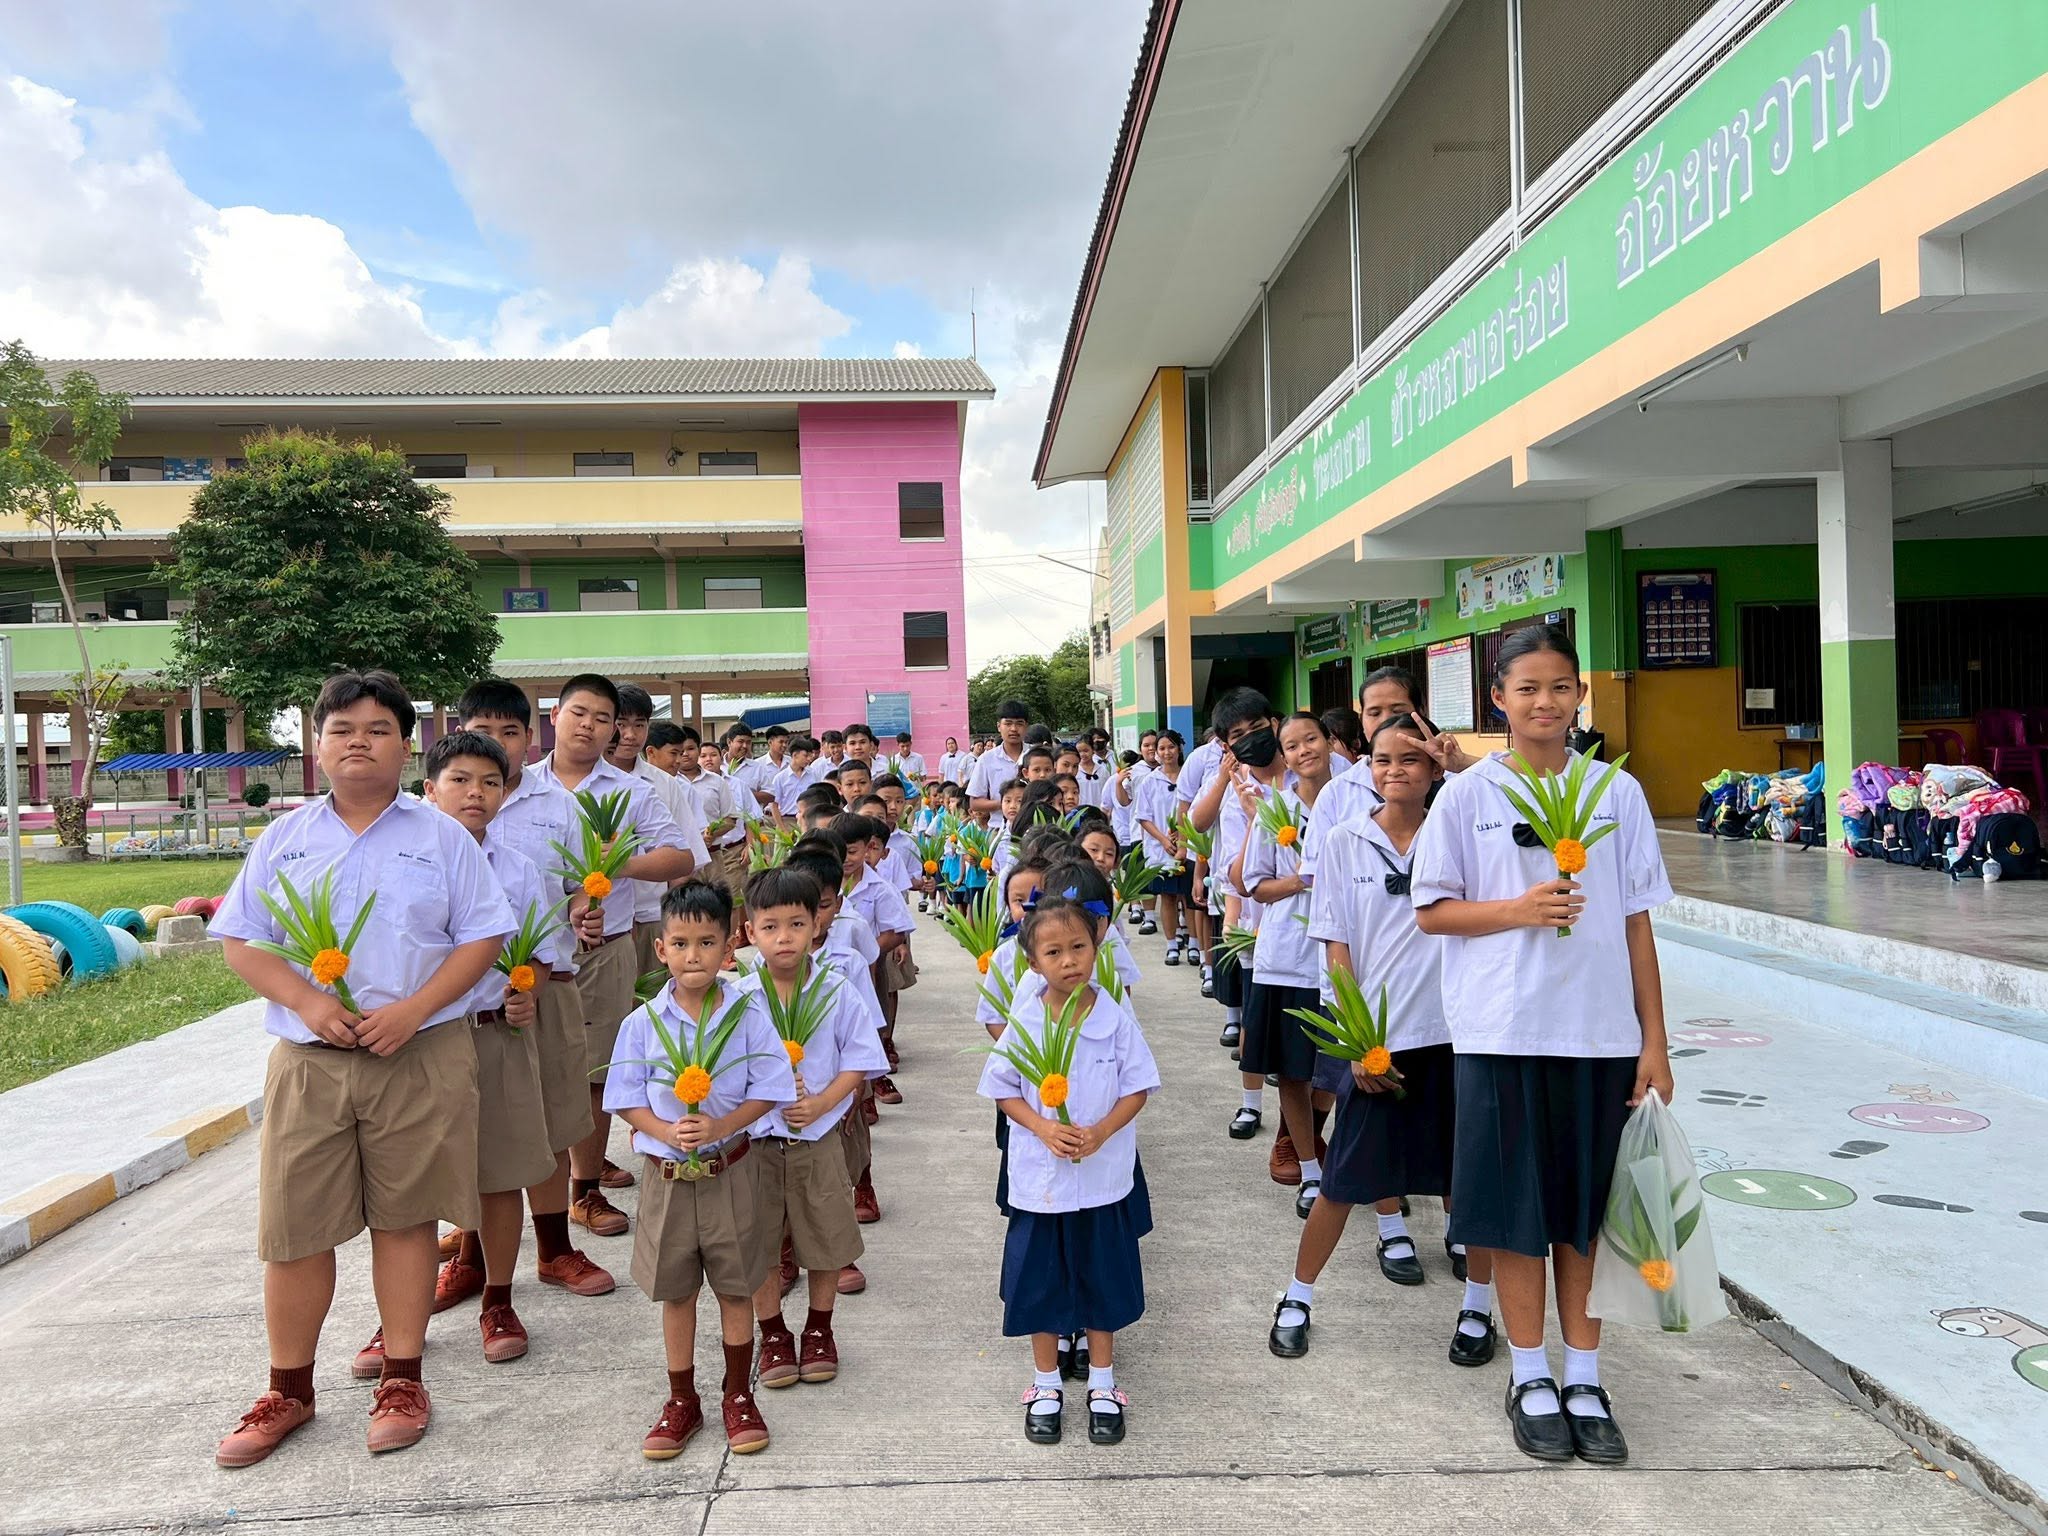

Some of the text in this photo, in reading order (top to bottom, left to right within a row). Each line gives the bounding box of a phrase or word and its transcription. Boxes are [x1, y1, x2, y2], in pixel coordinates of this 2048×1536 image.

[1391, 255, 1569, 448] ข้าวหลามอร่อย
[1614, 3, 1892, 289] อ้อยหวาน
